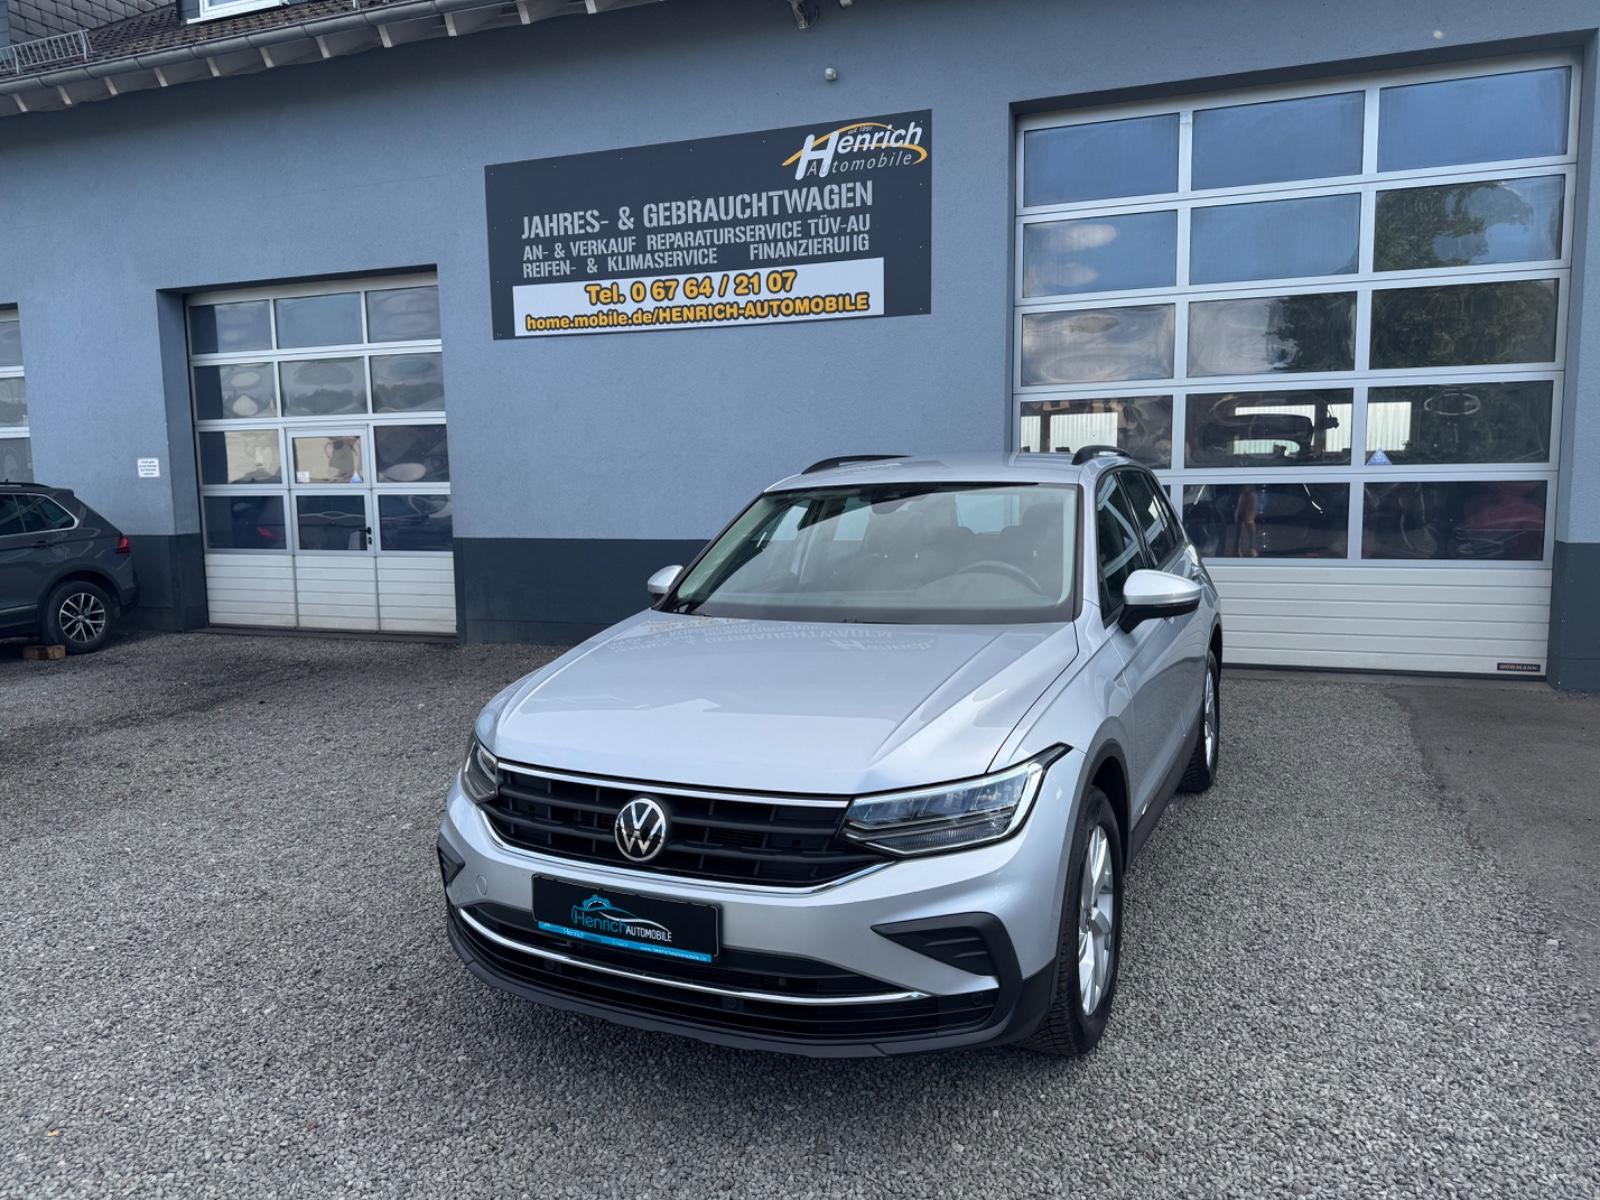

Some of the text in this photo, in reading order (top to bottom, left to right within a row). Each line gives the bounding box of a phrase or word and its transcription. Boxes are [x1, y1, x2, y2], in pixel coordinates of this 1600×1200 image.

[795, 121, 923, 180] Henrich
[521, 180, 873, 239] JAHRES- & GEBRAUCHTWAGEN
[523, 213, 871, 261] AN- & VERKAUF REPARATURSERVICE TÜV-AU
[523, 259, 577, 278] REIFEN-
[586, 257, 598, 274] &
[607, 248, 718, 272] KLIMASERVICE
[585, 268, 798, 306] Tel. 0 67 64 / 21 07
[525, 291, 871, 332] home.mobile.de/HENRICH-AUTOMOBILE
[615, 798, 667, 861] VW
[572, 906, 627, 934] Henrich
[625, 925, 673, 943] AUTOMOBILE
